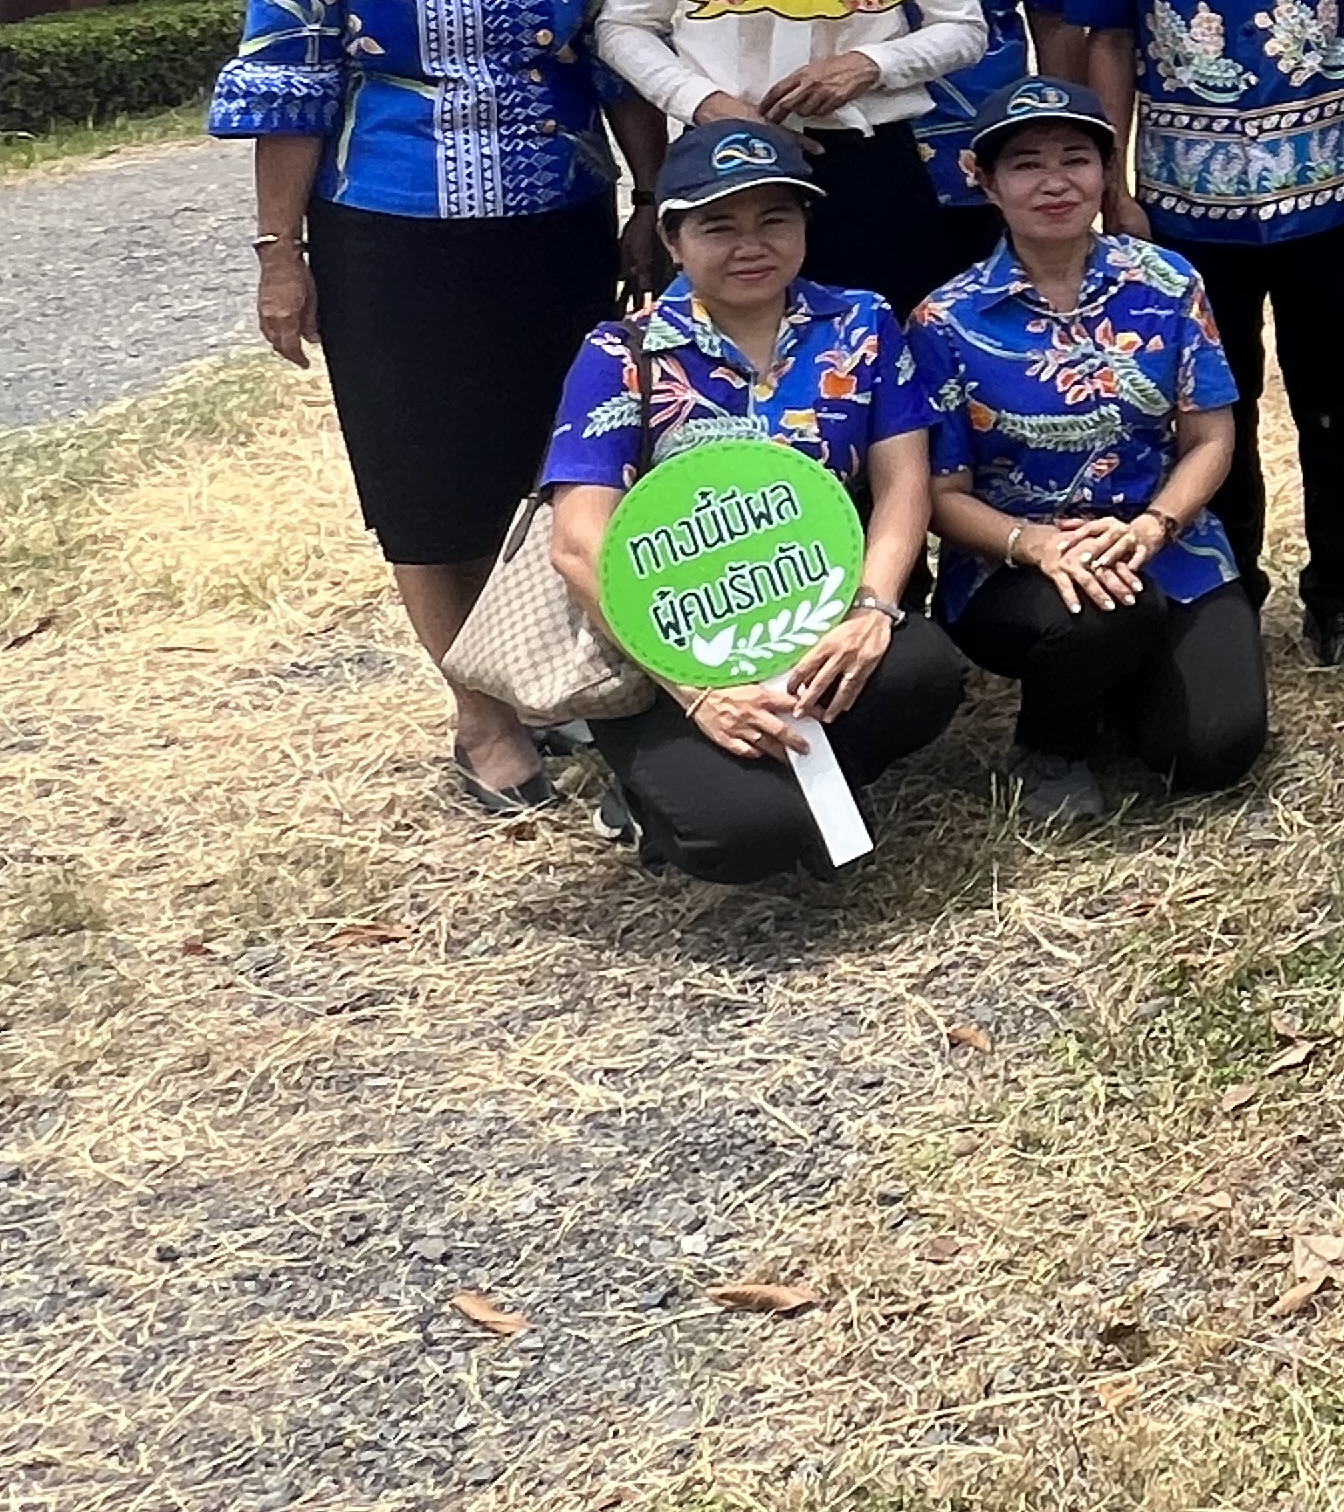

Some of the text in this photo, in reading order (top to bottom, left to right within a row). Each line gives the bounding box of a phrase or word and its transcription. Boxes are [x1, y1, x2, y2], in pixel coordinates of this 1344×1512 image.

[628, 484, 800, 575] ทางนี้มีผล
[652, 543, 830, 648] ผู้คนรักกัน
